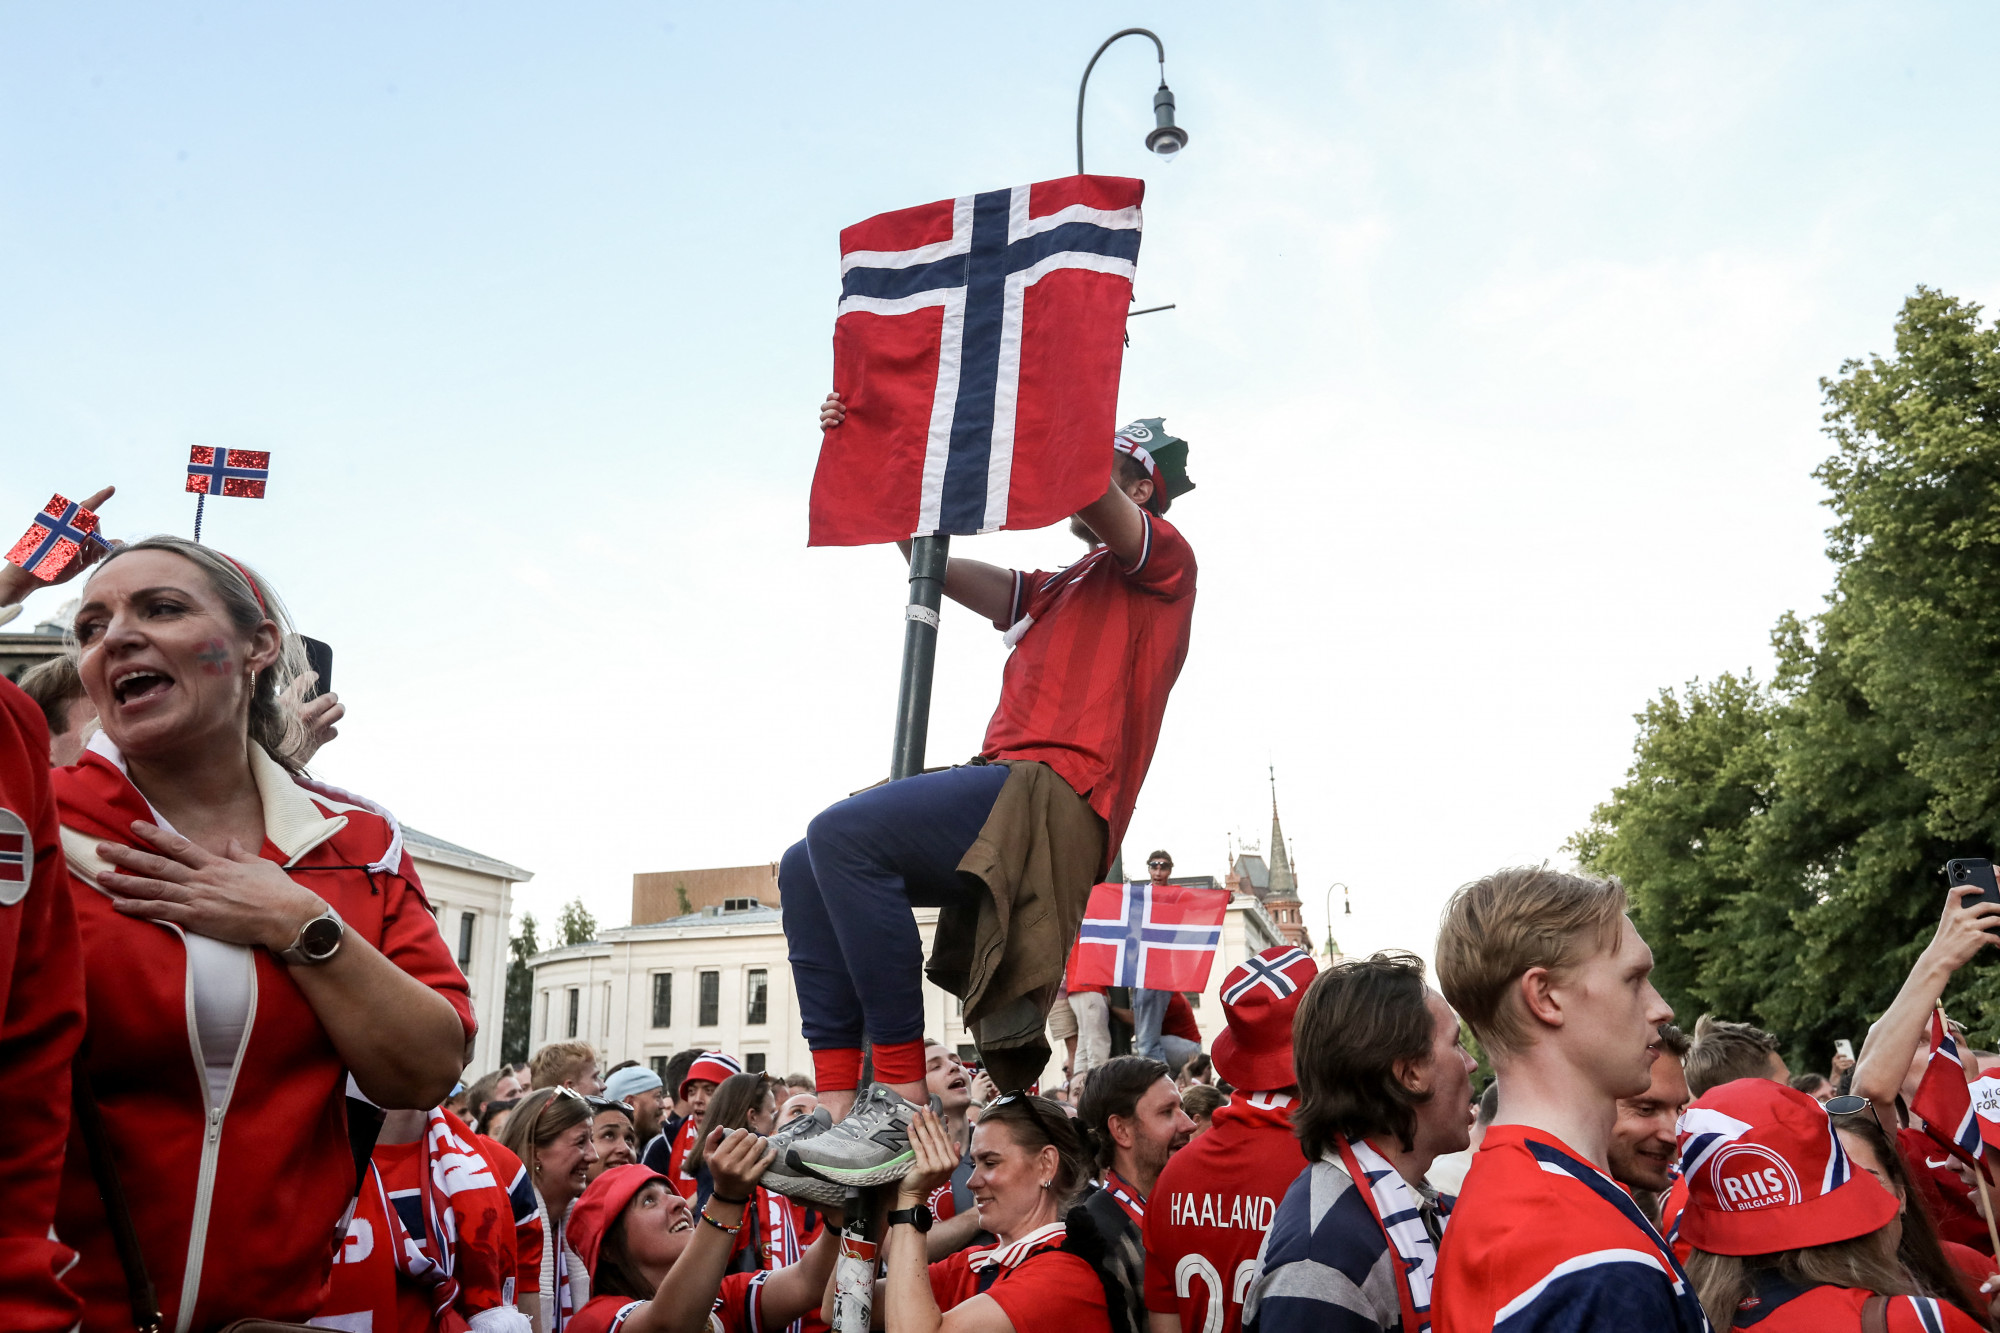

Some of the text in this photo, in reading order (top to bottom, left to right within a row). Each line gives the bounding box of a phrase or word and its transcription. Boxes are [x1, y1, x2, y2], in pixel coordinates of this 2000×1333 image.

[1982, 1089, 1992, 1099] VI
[1976, 1099, 2000, 1112] FOR
[1723, 1168, 1783, 1202] RIIS
[1737, 1194, 1785, 1211] BILGLASS
[1170, 1192, 1275, 1231] HAALAND
